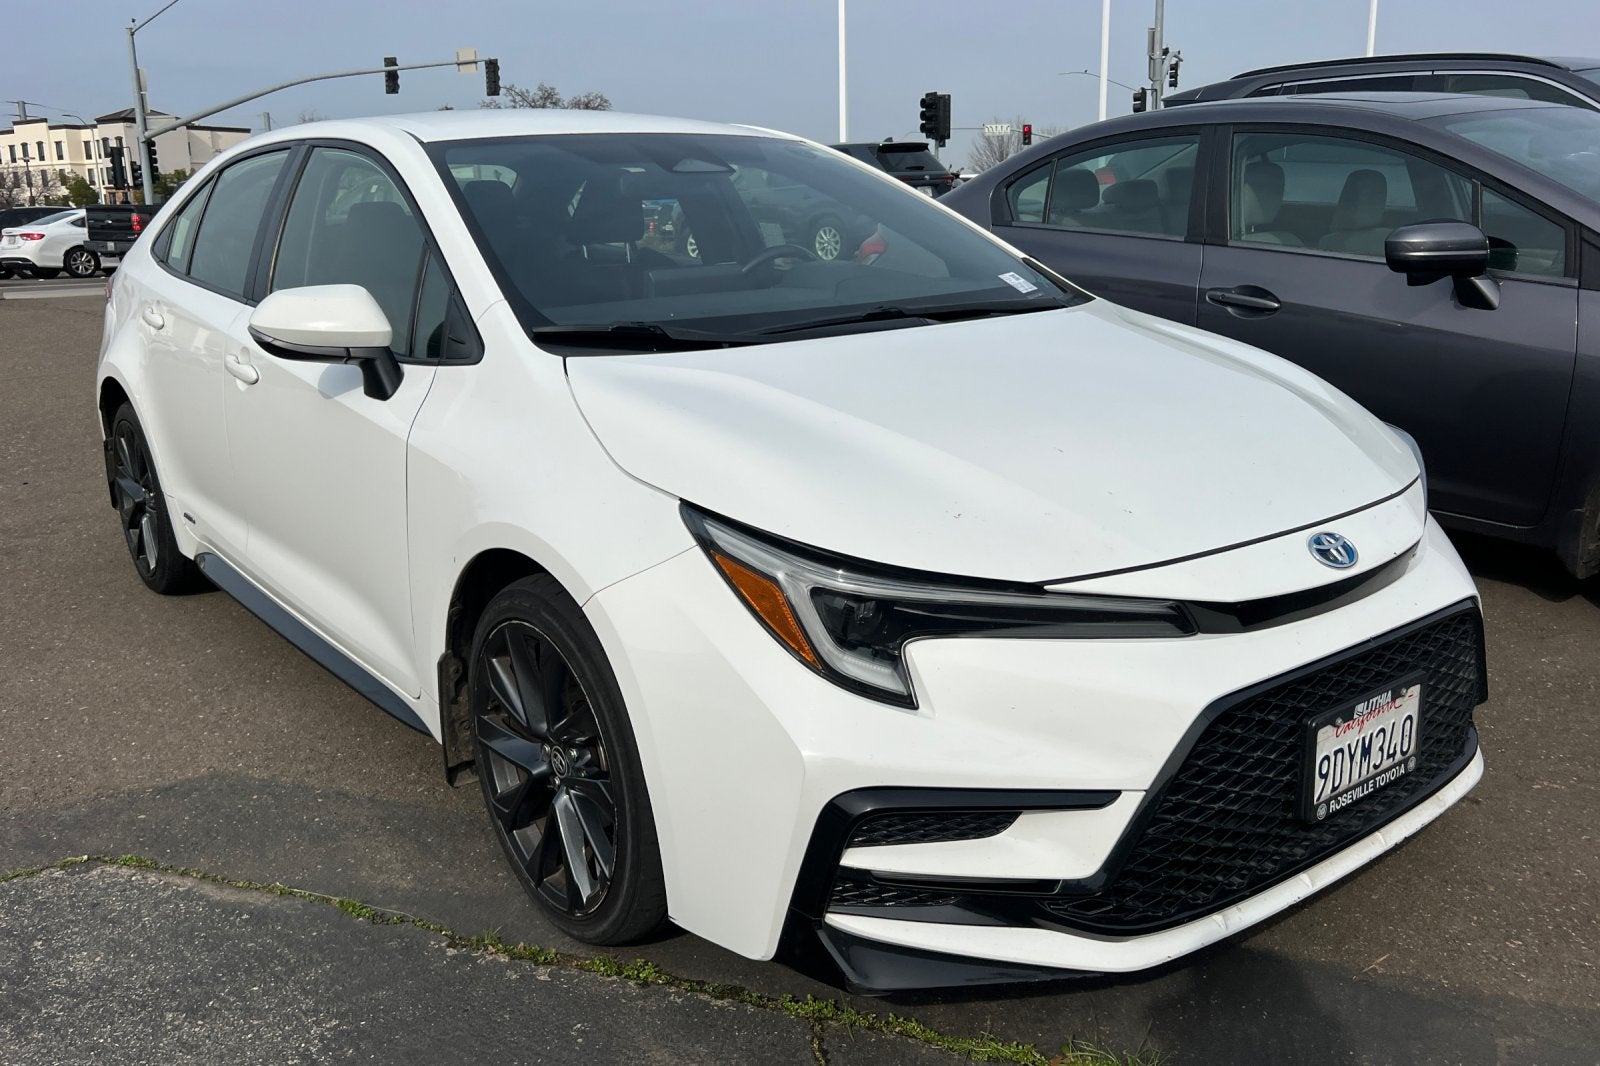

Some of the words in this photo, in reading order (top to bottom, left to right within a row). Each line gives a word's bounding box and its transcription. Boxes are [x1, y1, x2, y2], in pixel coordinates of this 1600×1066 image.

[1335, 698, 1402, 738] California
[1315, 714, 1413, 802] 9DYM340
[1329, 780, 1374, 813] ROSEVILLE
[1375, 763, 1405, 788] TOYOTA
